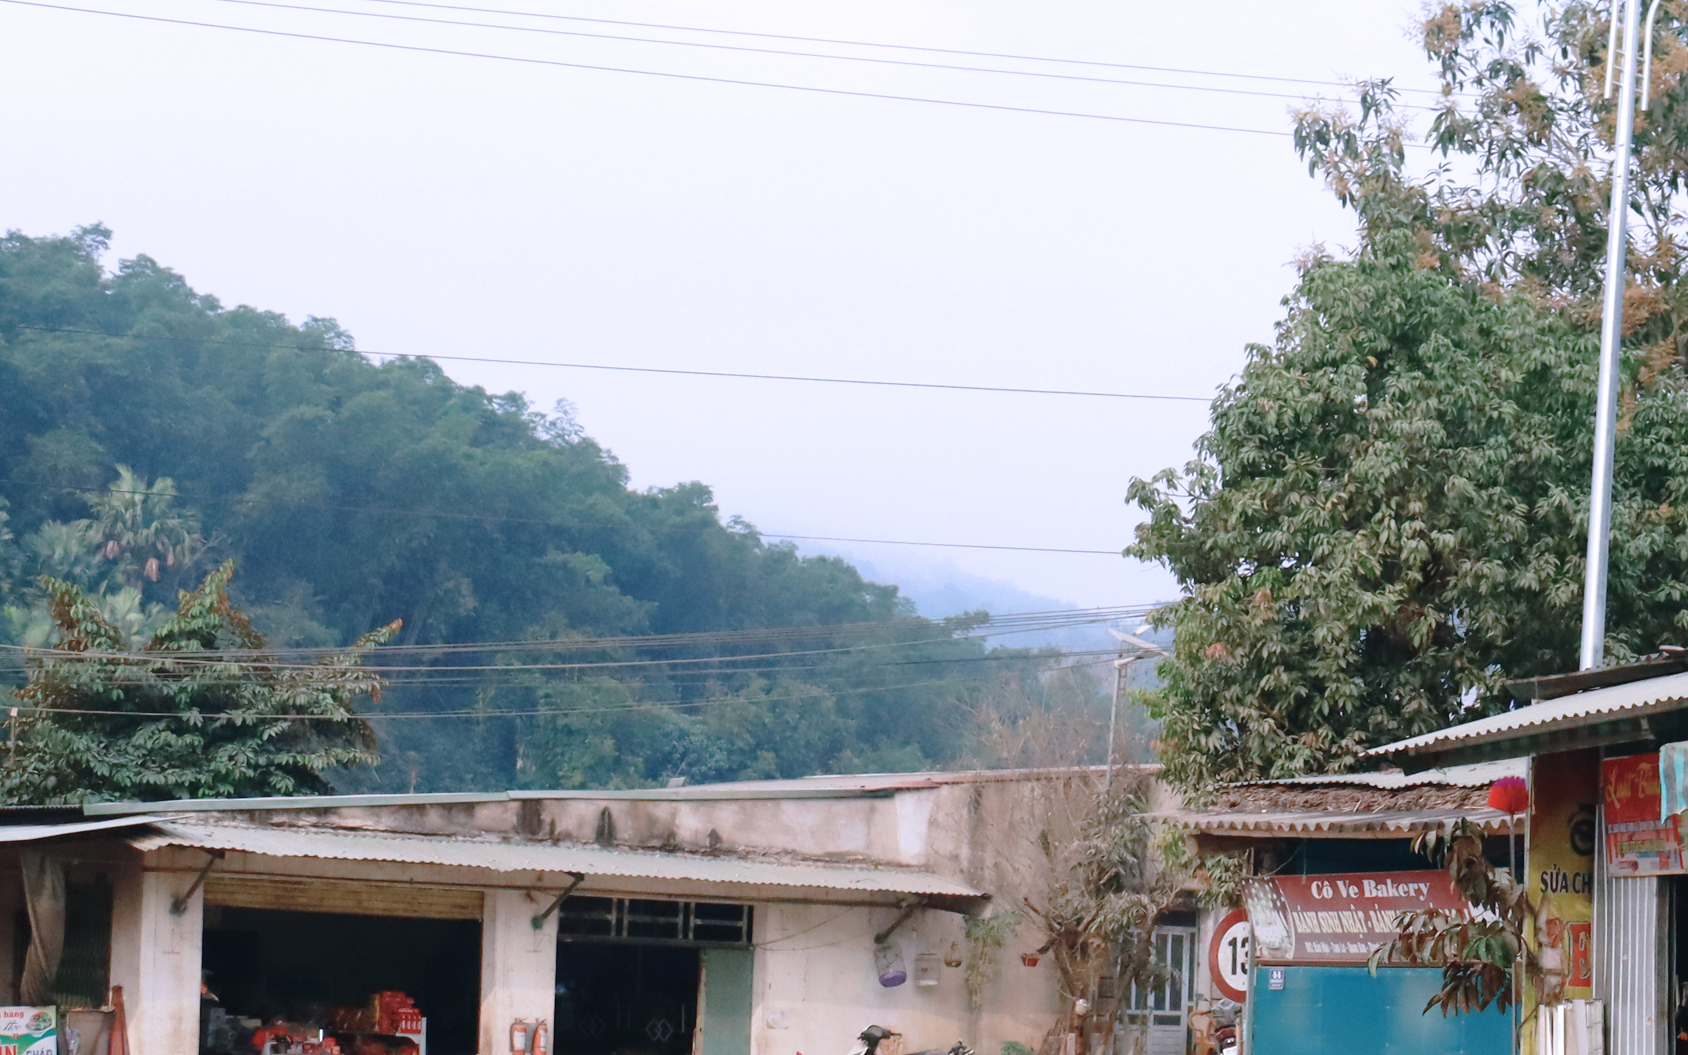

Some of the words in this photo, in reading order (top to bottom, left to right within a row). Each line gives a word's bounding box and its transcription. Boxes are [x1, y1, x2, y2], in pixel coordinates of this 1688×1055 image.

[1311, 880, 1334, 899] Cô
[1336, 880, 1359, 898] Ve
[1362, 878, 1430, 902] Bakery
[1540, 863, 1569, 894] SỬA
